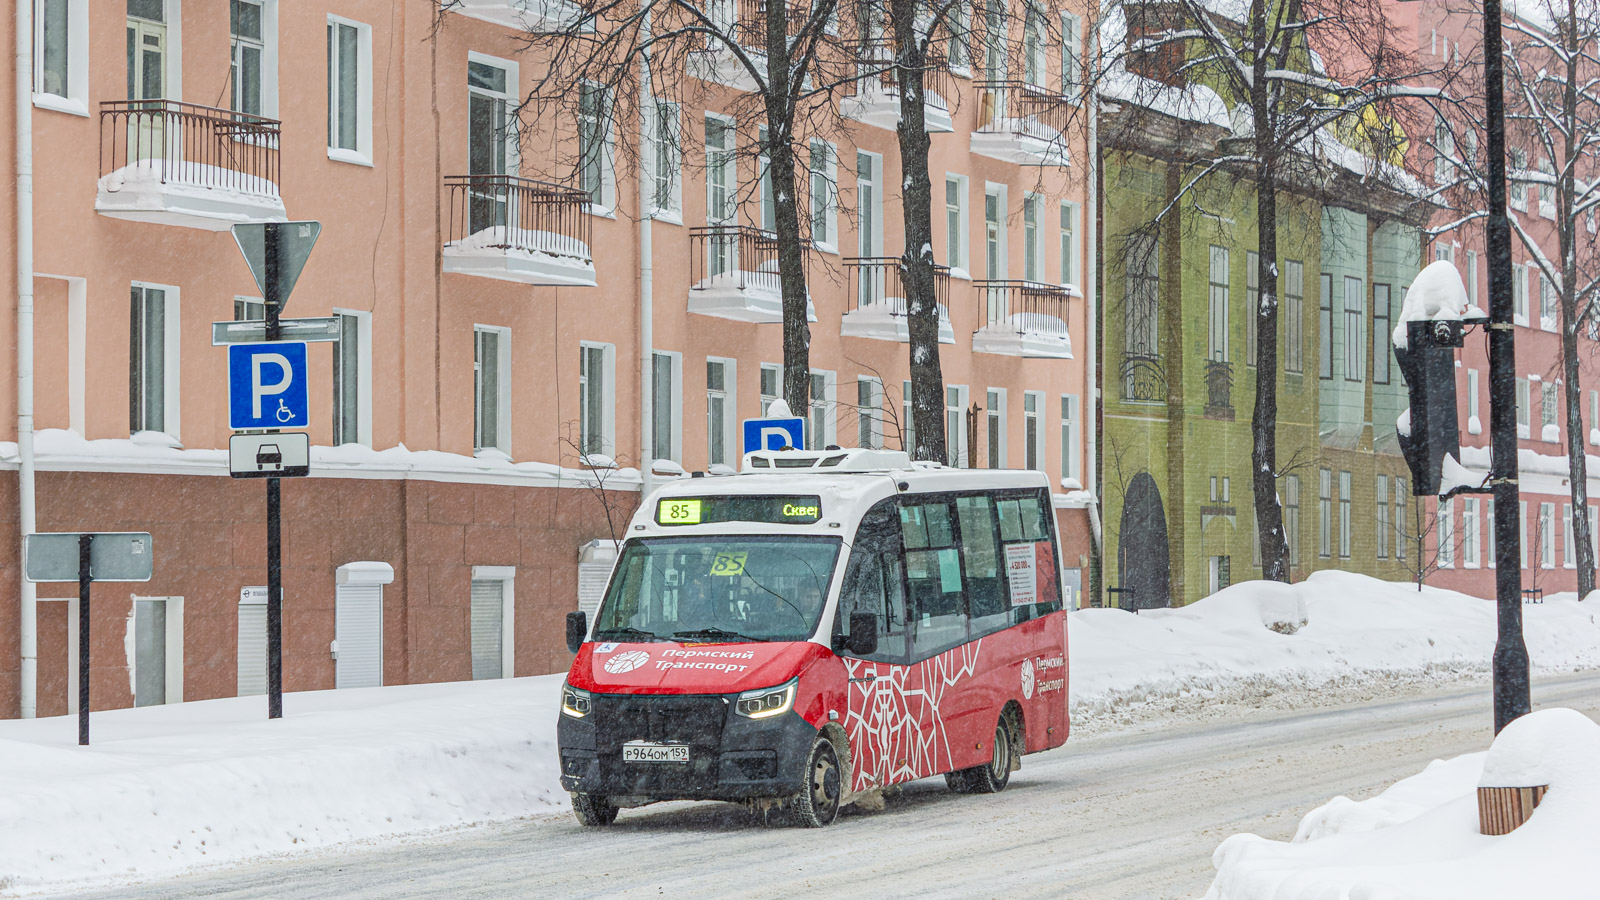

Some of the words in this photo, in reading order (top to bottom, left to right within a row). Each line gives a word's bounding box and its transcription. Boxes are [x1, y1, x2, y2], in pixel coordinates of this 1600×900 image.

[251, 353, 293, 419] P
[670, 504, 689, 519] 85
[713, 555, 745, 572] 85
[661, 649, 755, 660] Пермский
[655, 660, 748, 674] Транспорт
[1036, 653, 1064, 673] Пермский
[1037, 678, 1064, 697] Транспорт
[670, 747, 687, 757] 159
